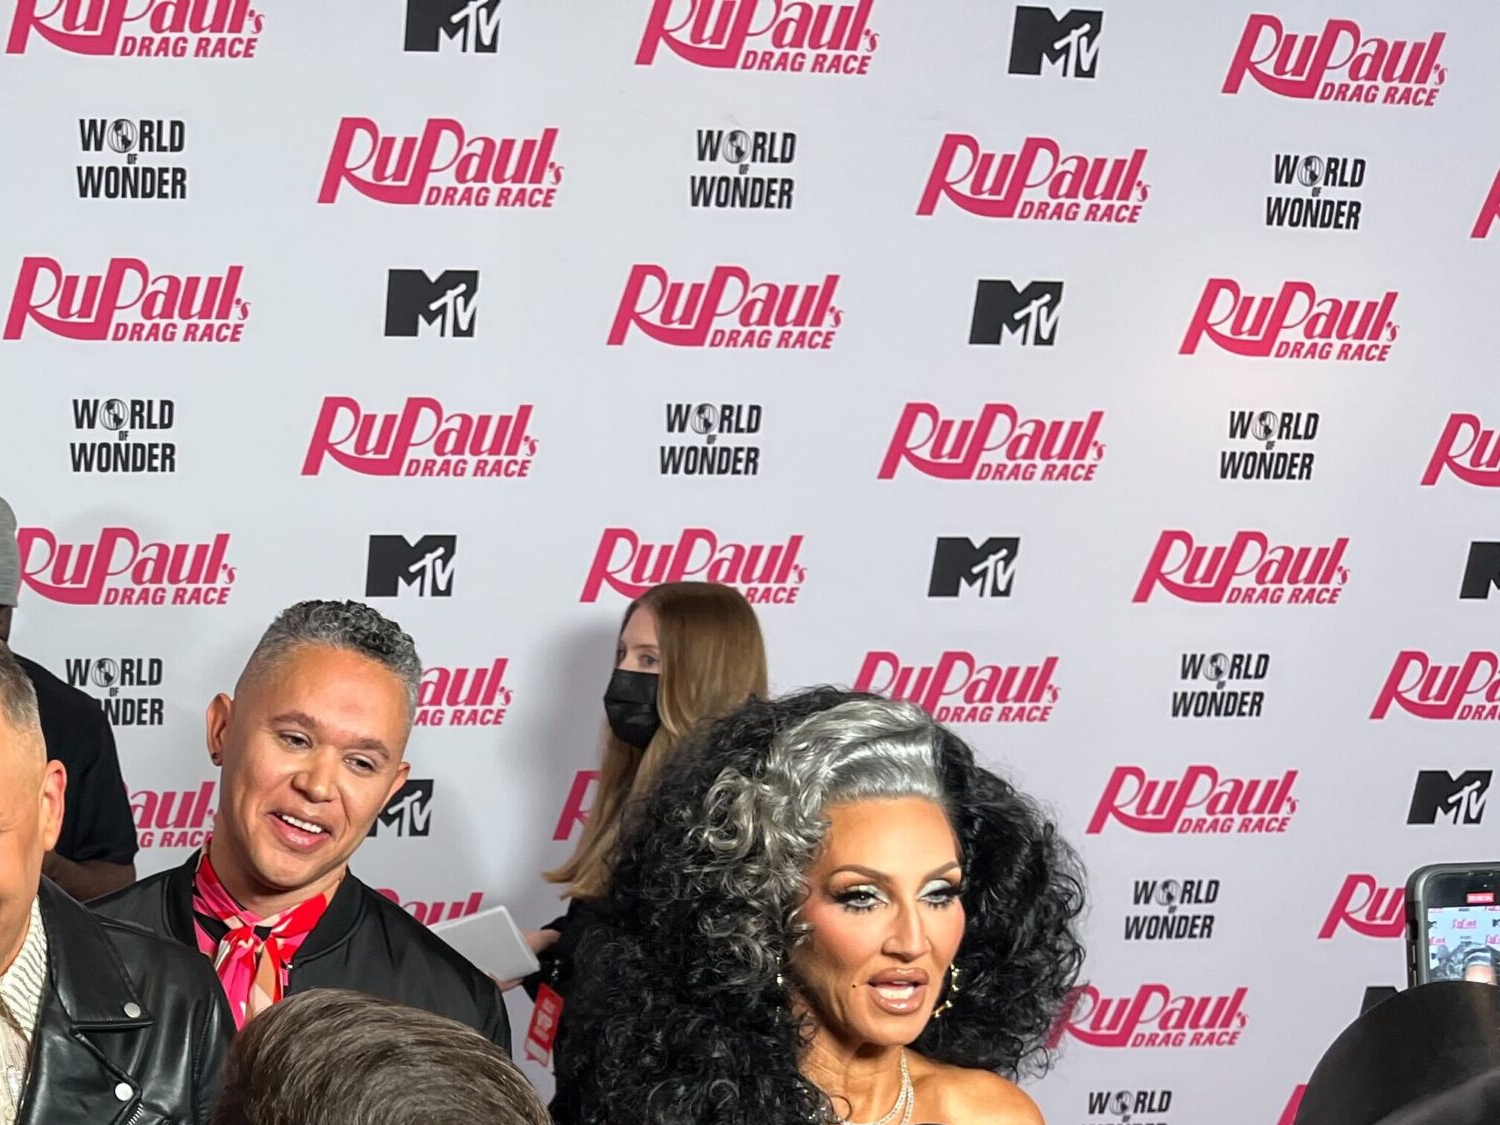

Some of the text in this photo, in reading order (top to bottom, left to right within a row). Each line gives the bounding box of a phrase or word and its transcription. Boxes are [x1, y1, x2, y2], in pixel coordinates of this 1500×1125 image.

[404, 0, 501, 53] MTV
[1008, 6, 1104, 78] MTV
[120, 35, 257, 58] DRAG RACE
[741, 49, 872, 74] DRAG RACE
[1223, 14, 1447, 99] RuPaul's
[1318, 81, 1439, 106] DRAG RACE
[318, 117, 563, 205] RuPaul's
[917, 134, 1150, 218] RuPaul's
[76, 166, 186, 199] WONDER
[425, 186, 557, 207] DRAG RACE
[691, 176, 794, 209] WONDER
[1018, 200, 1142, 223] DRAG RACE
[1266, 197, 1361, 230] WONDER
[4, 257, 250, 340] RuPaul's
[384, 268, 479, 338] MTV
[607, 264, 843, 347] RuPaul's
[968, 279, 1064, 346] MTV
[112, 322, 244, 342] DRAG RACE
[1180, 278, 1400, 357] RuPaul's
[709, 328, 835, 348] DRAG RACE
[1274, 340, 1391, 361] DRAG RACE
[302, 396, 538, 476] RuPaul's
[878, 402, 1105, 480] RuPaul's
[70, 442, 175, 472] WONDER
[405, 458, 531, 477] DRAG RACE
[660, 446, 760, 475] WONDER
[976, 463, 1097, 480] DRAG RACE
[1220, 451, 1314, 480] WONDER
[17, 528, 236, 605] RuPaul's
[365, 534, 457, 598] MTV
[580, 528, 807, 603] RuPaul's
[927, 537, 1020, 597] MTV
[1133, 530, 1351, 603] RuPaul's
[103, 586, 230, 605] DRAG RACE
[1226, 586, 1342, 603] DRAG RACE
[450, 708, 506, 725] RACE
[935, 705, 1053, 722] DRAG RACE
[1172, 691, 1264, 717] WONDER
[1087, 765, 1299, 834] RuPaul's
[1406, 769, 1493, 825] MTV
[1177, 816, 1290, 832] DRAG RACE
[1125, 914, 1215, 940] WONDER
[1131, 1032, 1186, 1048] DRAG
